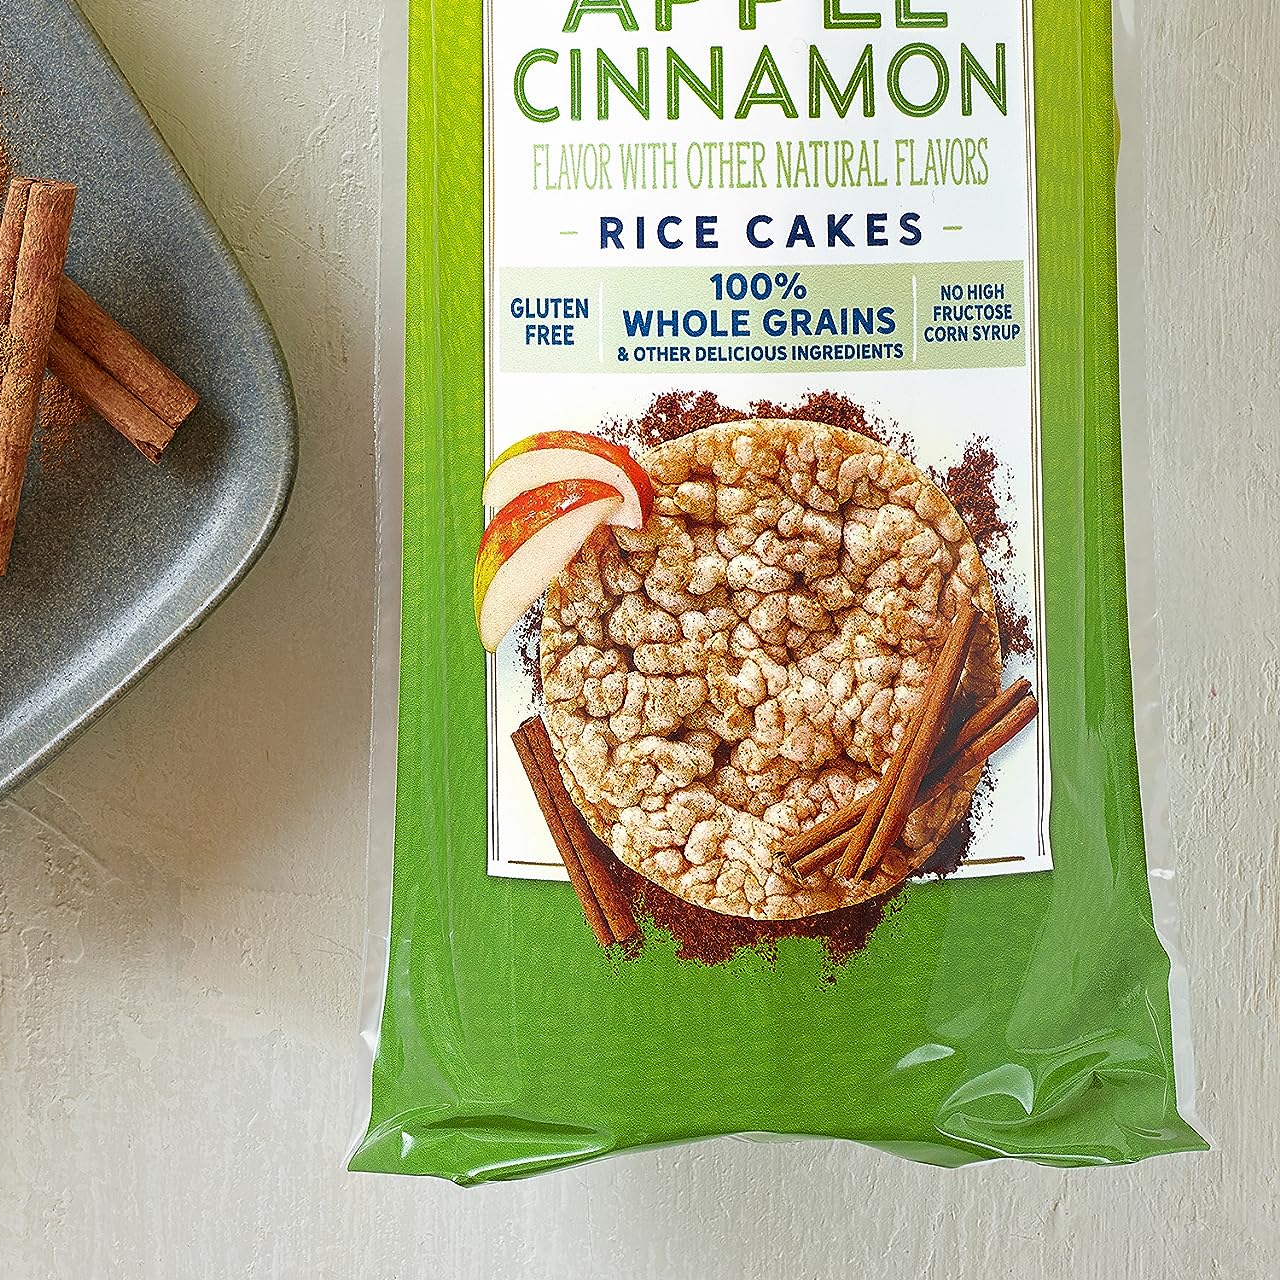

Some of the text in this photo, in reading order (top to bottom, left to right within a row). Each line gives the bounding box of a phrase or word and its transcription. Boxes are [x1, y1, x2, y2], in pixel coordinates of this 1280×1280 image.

[514, 42, 1007, 122] CINNAMON
[533, 138, 988, 190] FLAVOR WITH OTHER NATURAL FLAVORS
[600, 212, 921, 249] RICE CAKES
[710, 273, 807, 301] 100%
[941, 284, 1004, 301] NO HIGH
[511, 298, 588, 318] GLUTEN
[933, 304, 1013, 322] FRUCTOSE
[623, 307, 896, 337] WHOLE GRAINS
[924, 323, 1021, 342] CORN SYRUP
[526, 324, 575, 346] FREE
[617, 344, 904, 362] & OTHER DELICIOUS INGREDIENTS
